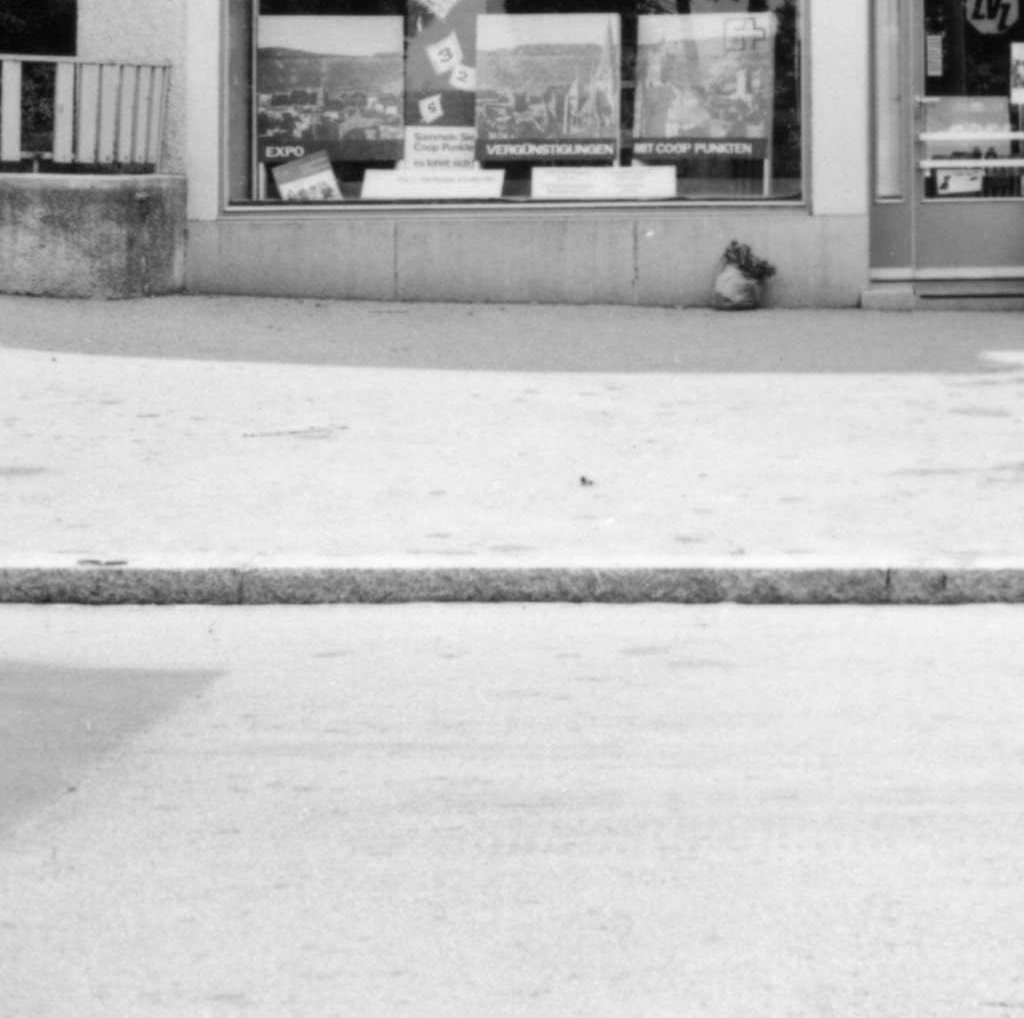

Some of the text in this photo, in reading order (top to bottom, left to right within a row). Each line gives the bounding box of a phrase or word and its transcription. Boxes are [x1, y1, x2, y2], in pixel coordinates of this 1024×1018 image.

[438, 47, 453, 63] 3
[456, 70, 468, 82] 2
[265, 146, 304, 158] EXPO
[413, 142, 440, 152] Coop
[486, 142, 614, 155] VERGÜNSTIGUNGEN
[633, 142, 752, 154] MIT COOP PUNKTEN
